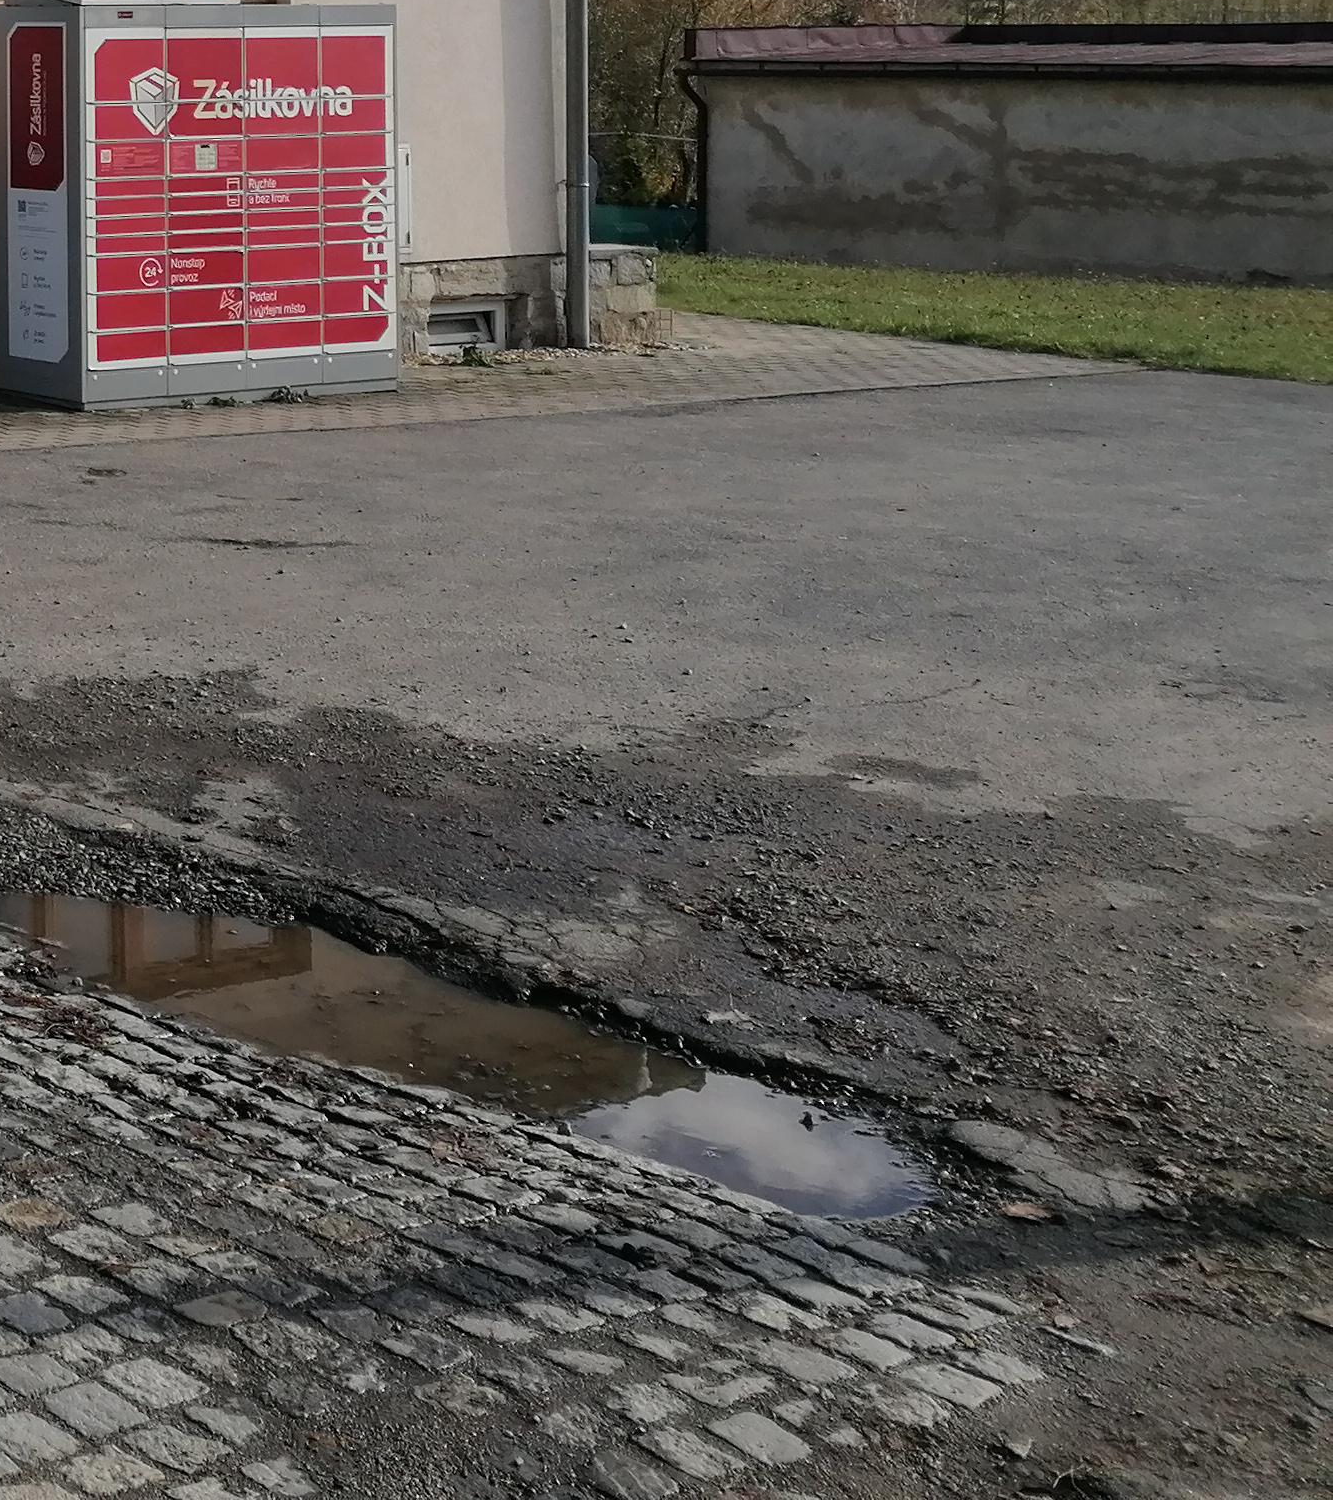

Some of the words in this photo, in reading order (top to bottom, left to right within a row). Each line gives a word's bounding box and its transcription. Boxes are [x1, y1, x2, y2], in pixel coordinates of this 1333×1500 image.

[29, 53, 42, 135] Zásilkovna
[193, 78, 353, 119] Zásilkovna
[248, 178, 277, 191] Rychle
[255, 194, 270, 204] bez
[362, 177, 388, 311] Z-BOX
[171, 257, 205, 270] Nonstop
[144, 266, 156, 278] 24
[171, 273, 199, 285] provoz
